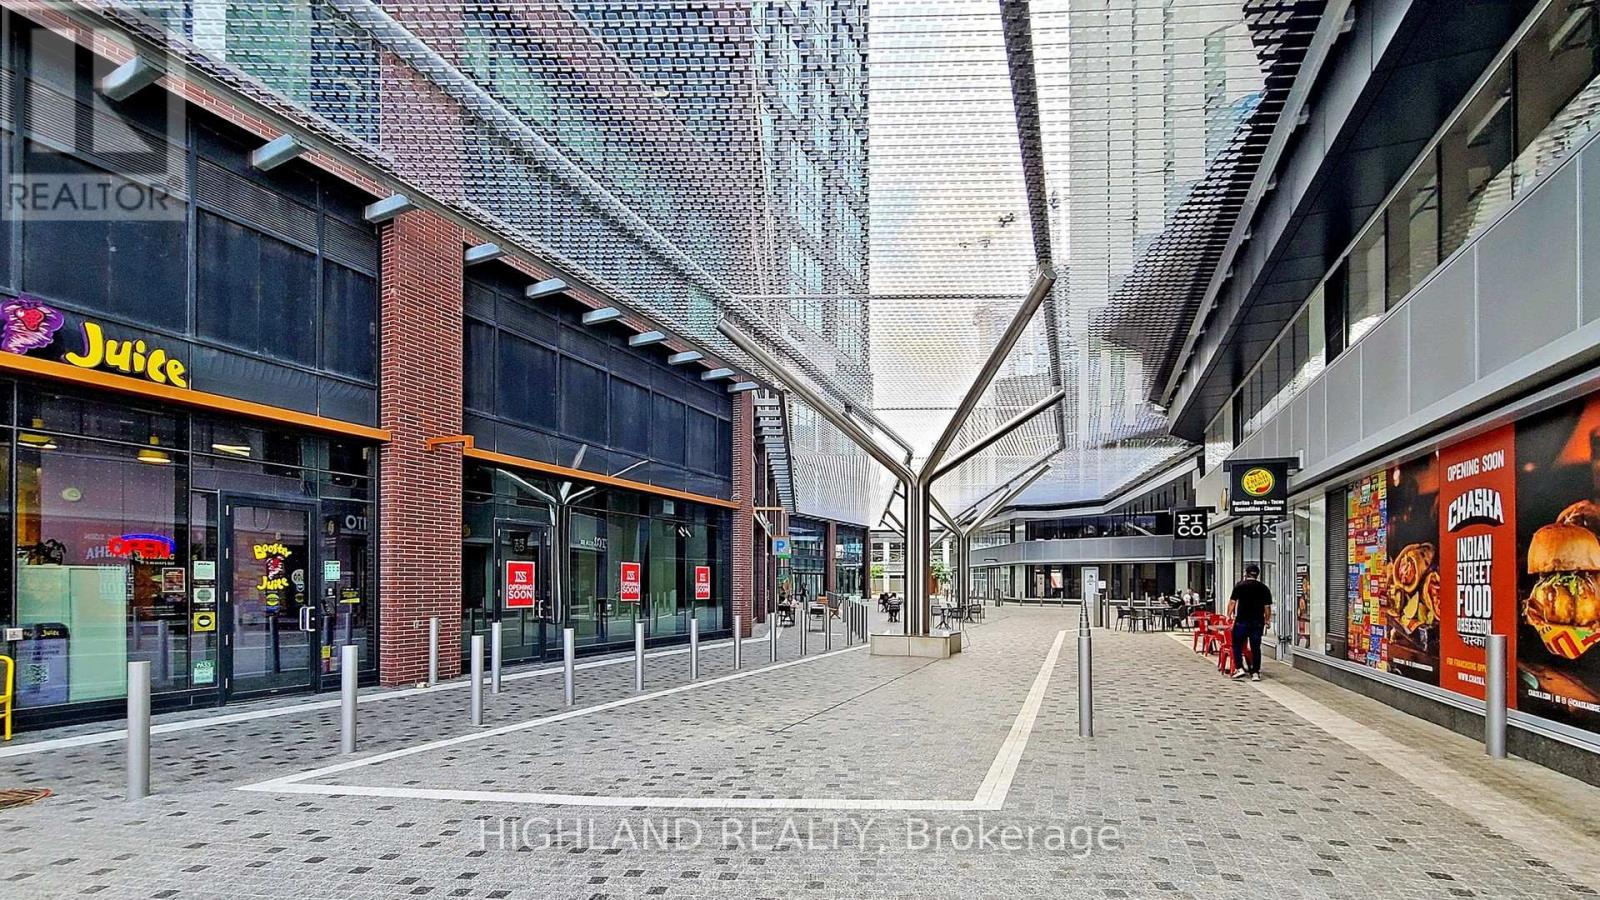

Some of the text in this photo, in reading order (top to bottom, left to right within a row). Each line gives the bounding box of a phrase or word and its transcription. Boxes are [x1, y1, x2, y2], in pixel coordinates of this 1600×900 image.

[65, 321, 187, 388] Juice
[1447, 449, 1504, 482] OPENING SOON
[1178, 514, 1203, 525] PI
[1447, 488, 1505, 532] CHASKA
[1178, 525, 1206, 536] CO.
[253, 543, 292, 560] Booster
[1456, 534, 1492, 562] INDIAN
[1456, 560, 1492, 584] STREET
[256, 576, 289, 592] Juice
[508, 590, 533, 599] SOON
[1456, 584, 1492, 618] FOOD
[1456, 617, 1492, 636] OBSESSION
